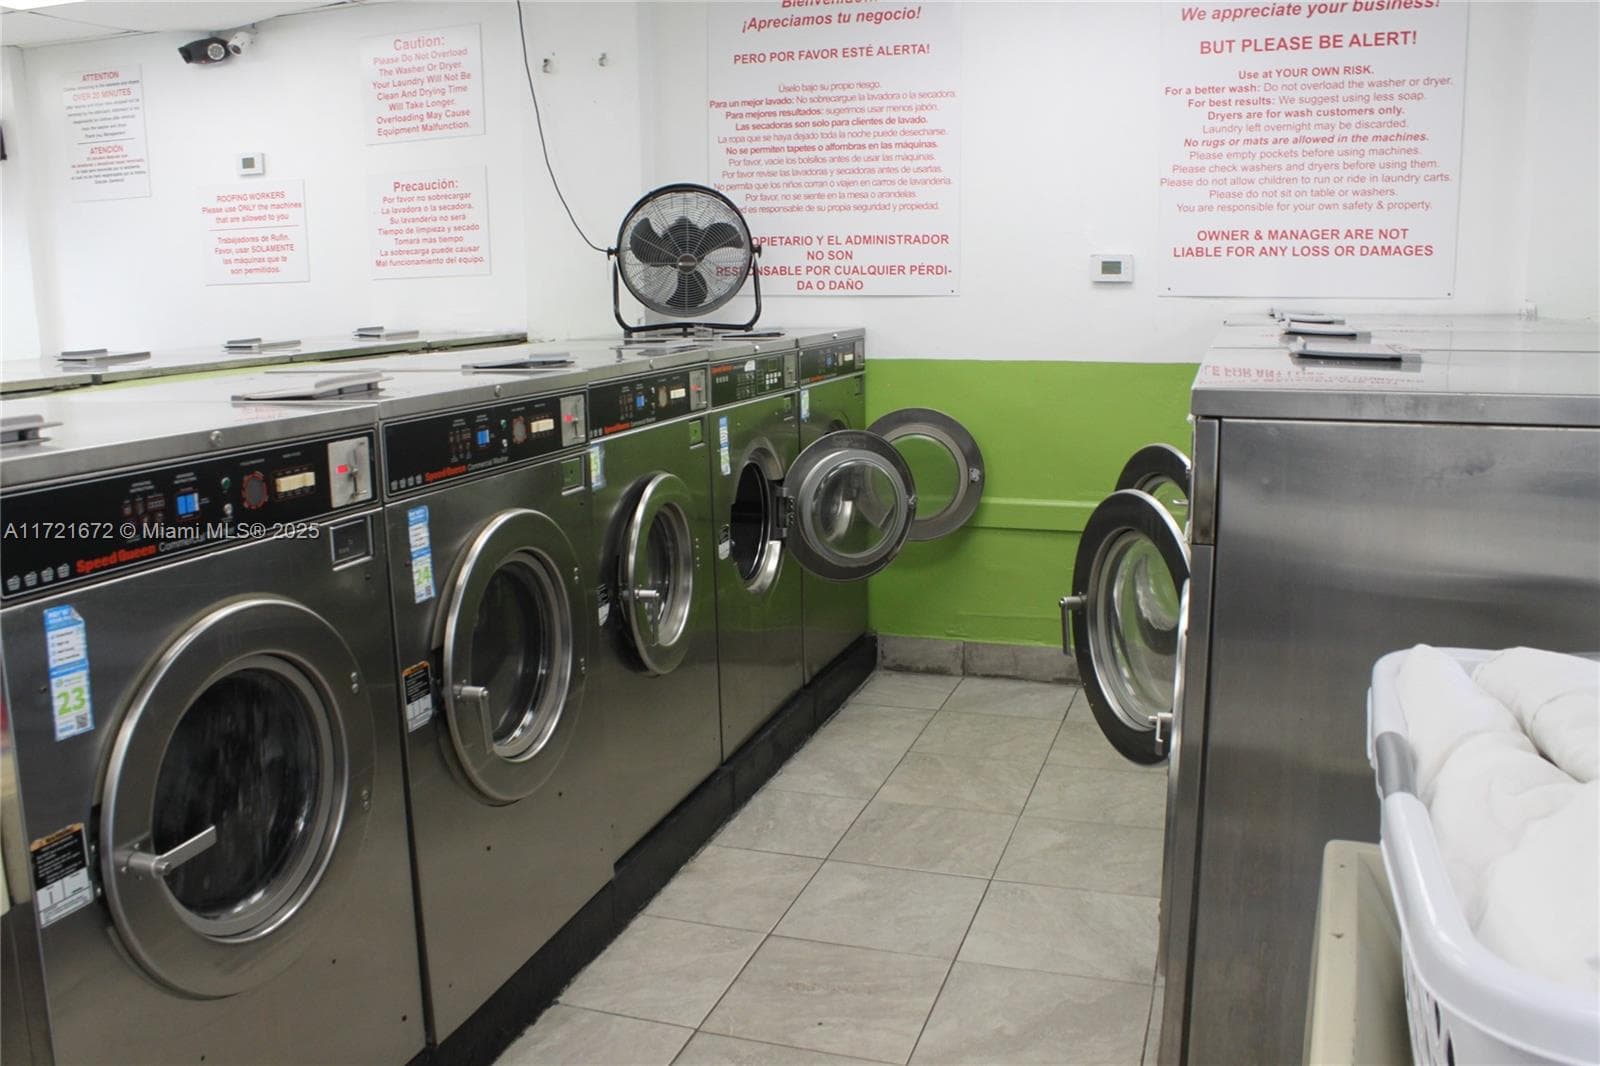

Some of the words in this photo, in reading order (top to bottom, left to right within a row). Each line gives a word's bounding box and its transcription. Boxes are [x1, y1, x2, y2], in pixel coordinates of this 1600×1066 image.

[1181, 7, 1206, 21] We
[1212, 2, 1302, 23] appreciate
[1307, 2, 1347, 18] your
[1352, 0, 1440, 12] business!
[743, 13, 832, 33] ¡Apreciamos
[837, 12, 851, 24] tu
[856, 8, 921, 26] negocio!
[394, 35, 445, 50] Caution:
[1200, 40, 1236, 54] BUT
[1241, 36, 1314, 52] PLEASE
[1319, 35, 1344, 49] BE
[1349, 32, 1417, 48] ALERT!
[734, 53, 766, 64] PERO
[769, 51, 795, 62] POR
[798, 49, 838, 61] FAVOR
[842, 45, 873, 58] ESTÉ
[876, 44, 930, 56] ALERTA!
[82, 72, 119, 81] ATTENTION
[1238, 69, 1259, 79] Use
[1262, 69, 1272, 78] at
[1275, 67, 1308, 78] YOUR
[1311, 66, 1340, 76] OWN
[1343, 64, 1374, 75] RISK.
[1165, 86, 1182, 95] For
[1194, 84, 1225, 94] better
[1228, 83, 1261, 93] wash:
[1263, 82, 1278, 92] Do
[1280, 82, 1297, 91] not
[1300, 80, 1344, 90] overload
[1347, 79, 1364, 88] the
[1367, 78, 1405, 88] washer
[1422, 76, 1453, 88] dryer.
[1188, 98, 1205, 107] For
[1208, 97, 1231, 107] best
[1234, 96, 1276, 106] results:
[1278, 95, 1295, 104] We
[1298, 93, 1339, 106] suggest
[1342, 92, 1370, 104] using
[1373, 91, 1394, 101] less
[1397, 92, 1425, 102] soap.
[1207, 110, 1242, 122] Dryers
[1265, 109, 1281, 118] for
[1284, 108, 1313, 117] wash
[1316, 106, 1374, 116] customers
[1378, 104, 1404, 116] only.
[736, 122, 749, 130] Las
[751, 120, 792, 130] secadoras
[811, 119, 829, 128] solo
[831, 120, 849, 129] para
[851, 117, 883, 126] clientes
[885, 116, 895, 125] de
[897, 115, 928, 124] lavado.
[1184, 138, 1198, 147] No
[1201, 139, 1225, 149] rugs
[1242, 136, 1268, 146] mats
[1292, 134, 1334, 144] allowed
[1337, 134, 1347, 143] in
[1351, 133, 1368, 143] the
[1371, 132, 1429, 142] machines.
[1173, 164, 1205, 173] Please
[1208, 163, 1237, 173] check
[1240, 162, 1282, 172] washers
[1285, 162, 1304, 171] and
[1307, 161, 1339, 173] dryers
[1342, 160, 1375, 170] before
[1378, 160, 1407, 171] using
[1410, 159, 1440, 168] them.
[393, 178, 458, 192] Precaución:
[1177, 203, 1195, 212] You
[1216, 202, 1273, 214] responsible
[1276, 202, 1289, 211] for
[1293, 204, 1314, 213] your
[1342, 201, 1373, 213] safety
[1376, 201, 1384, 210] &
[1386, 200, 1432, 212] property.
[816, 235, 824, 245] Y
[827, 235, 842, 245] EL
[845, 235, 949, 245] ADMINISTRADOR
[1197, 229, 1250, 241] OWNER
[1254, 229, 1264, 240] &
[1267, 229, 1340, 240] MANAGER
[1344, 228, 1374, 239] ARE
[1378, 228, 1408, 239] NOT
[807, 251, 824, 260] NO
[827, 250, 853, 260] SON
[1173, 246, 1222, 257] LIABLE
[1226, 246, 1254, 257] FOR
[1258, 246, 1288, 257] ANY
[1291, 246, 1330, 257] LOSS
[1334, 246, 1355, 256] OR
[1359, 245, 1433, 256] DAMAGES
[805, 266, 831, 276] POR
[834, 265, 906, 275] CUALQUIER
[909, 262, 952, 275] PÉRDI-
[797, 280, 813, 290] DA
[816, 280, 825, 290] O
[828, 278, 863, 290] DAÑO
[56, 686, 86, 716] 23
